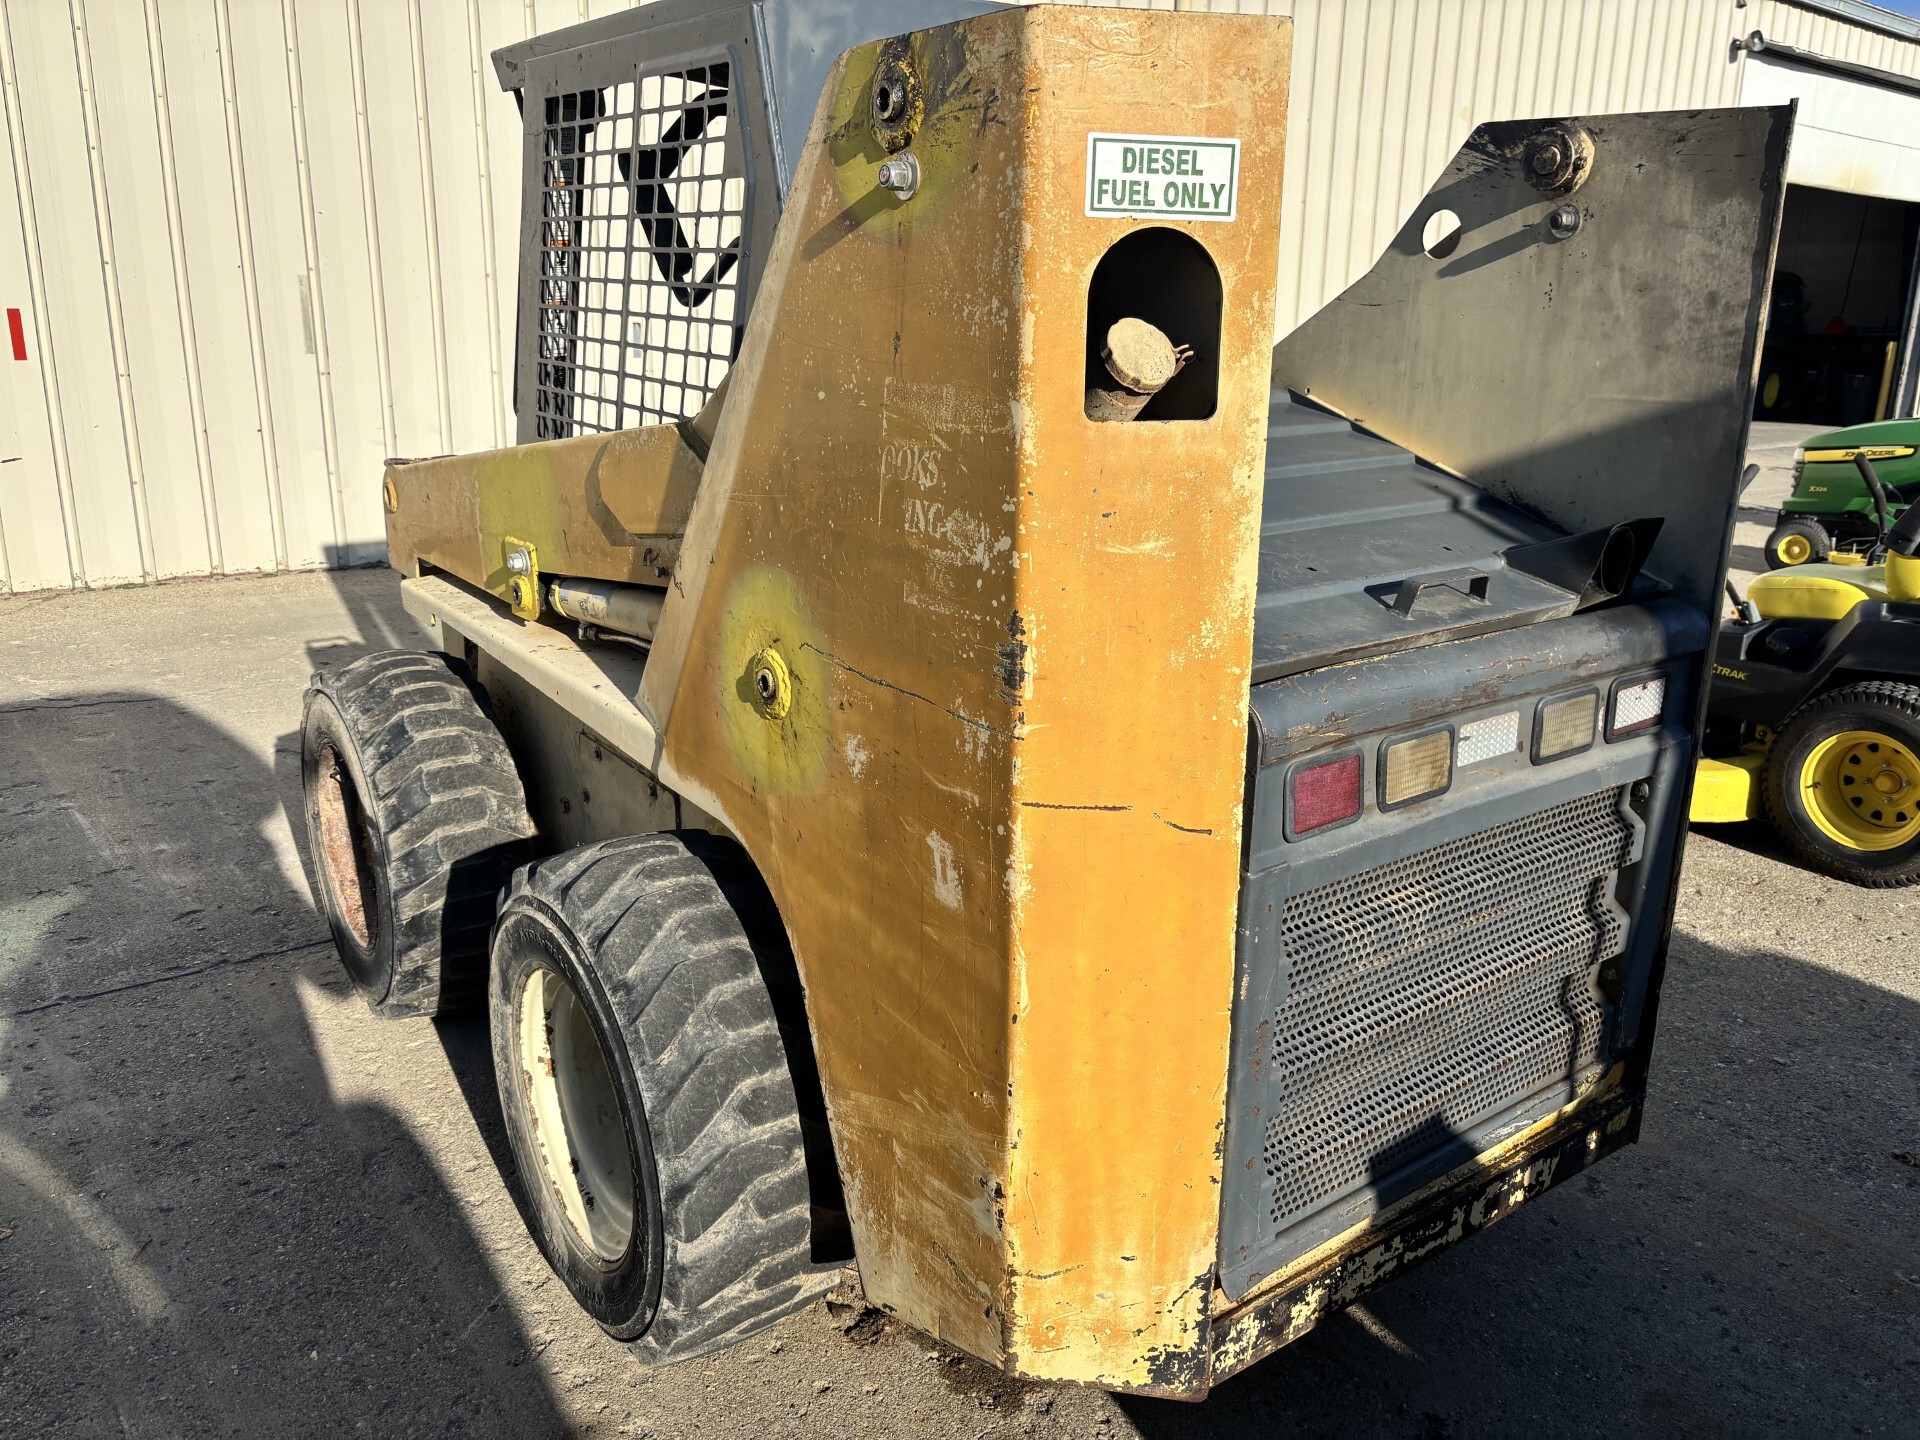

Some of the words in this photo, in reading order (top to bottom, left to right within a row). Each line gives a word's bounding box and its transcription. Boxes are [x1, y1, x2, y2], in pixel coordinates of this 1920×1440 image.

[1122, 146, 1203, 176] DIESEL
[1097, 178, 1156, 206] FUEL
[1163, 181, 1226, 209] ONLY
[1866, 449, 1897, 457] DEERE
